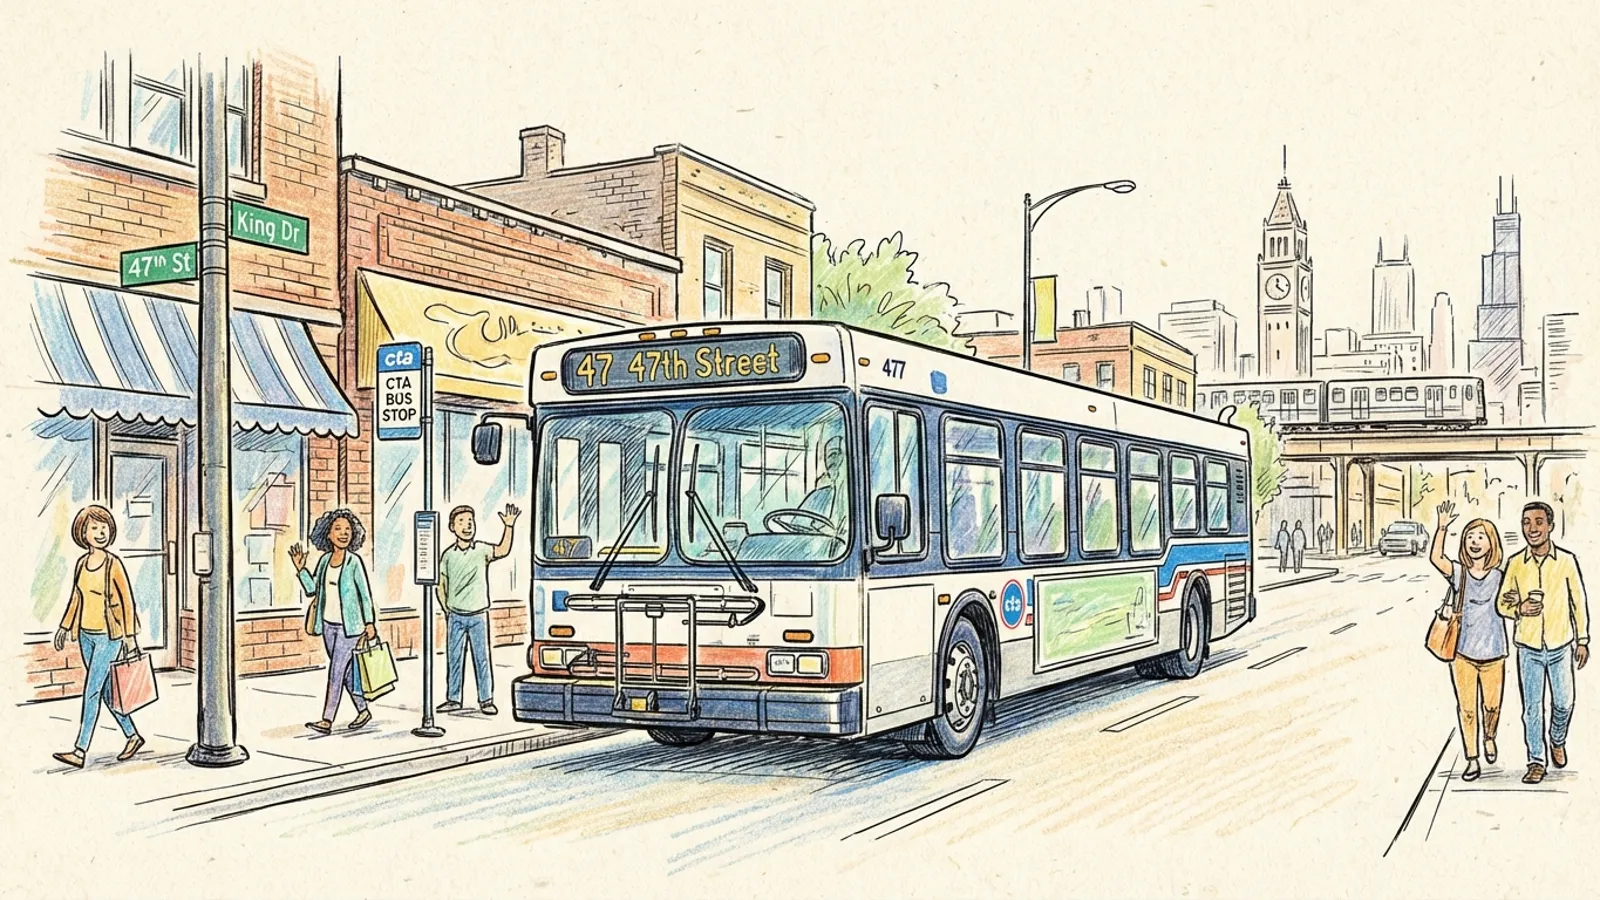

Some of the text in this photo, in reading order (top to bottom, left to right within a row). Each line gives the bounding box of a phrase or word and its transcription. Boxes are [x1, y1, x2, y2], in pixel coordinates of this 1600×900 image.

[238, 210, 300, 243] King Dr
[128, 252, 191, 278] 47th St
[384, 350, 414, 367] cta
[576, 343, 780, 388] 47 47th Street
[882, 358, 906, 379] 477
[386, 376, 412, 390] CTA
[386, 392, 413, 406] BUS
[382, 408, 417, 422] STOP
